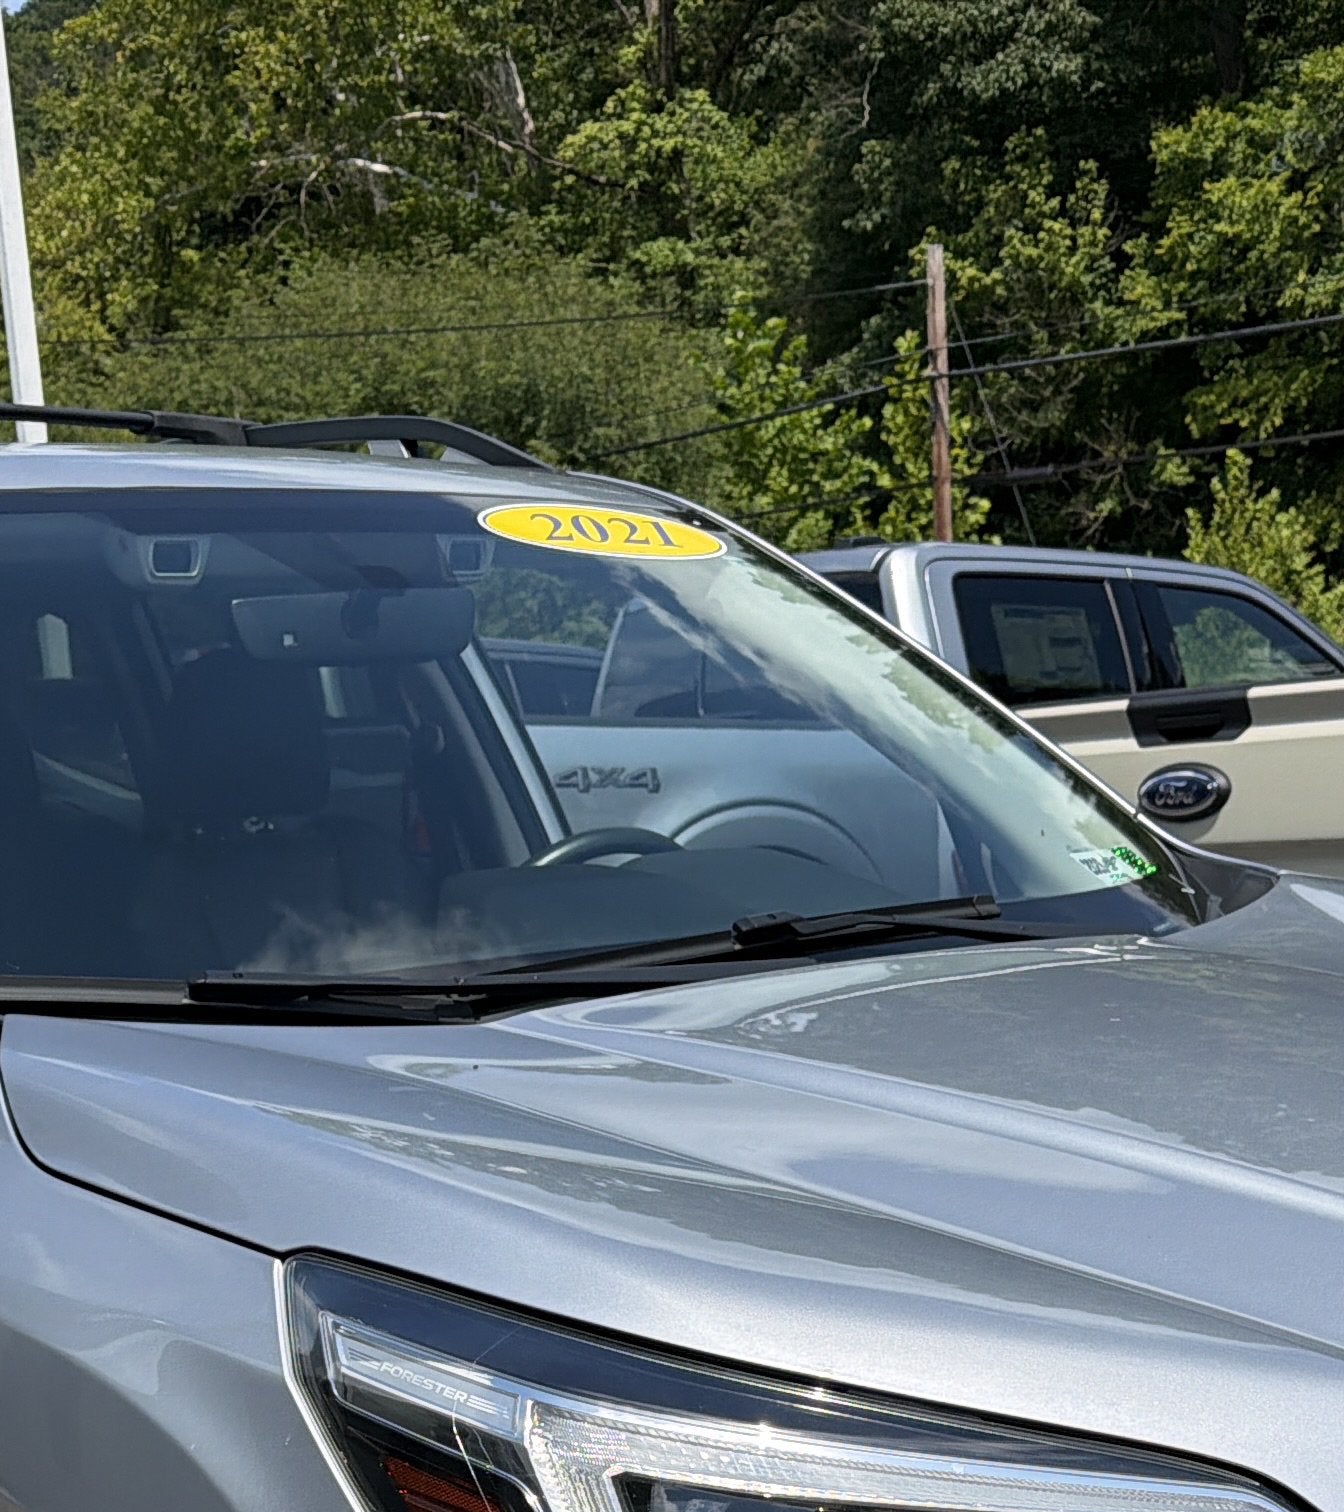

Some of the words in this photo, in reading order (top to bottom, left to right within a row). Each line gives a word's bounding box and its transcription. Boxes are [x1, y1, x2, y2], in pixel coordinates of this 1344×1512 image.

[529, 513, 684, 548] 2021
[1154, 780, 1199, 806] Ford
[380, 1362, 470, 1404] FORESTER
